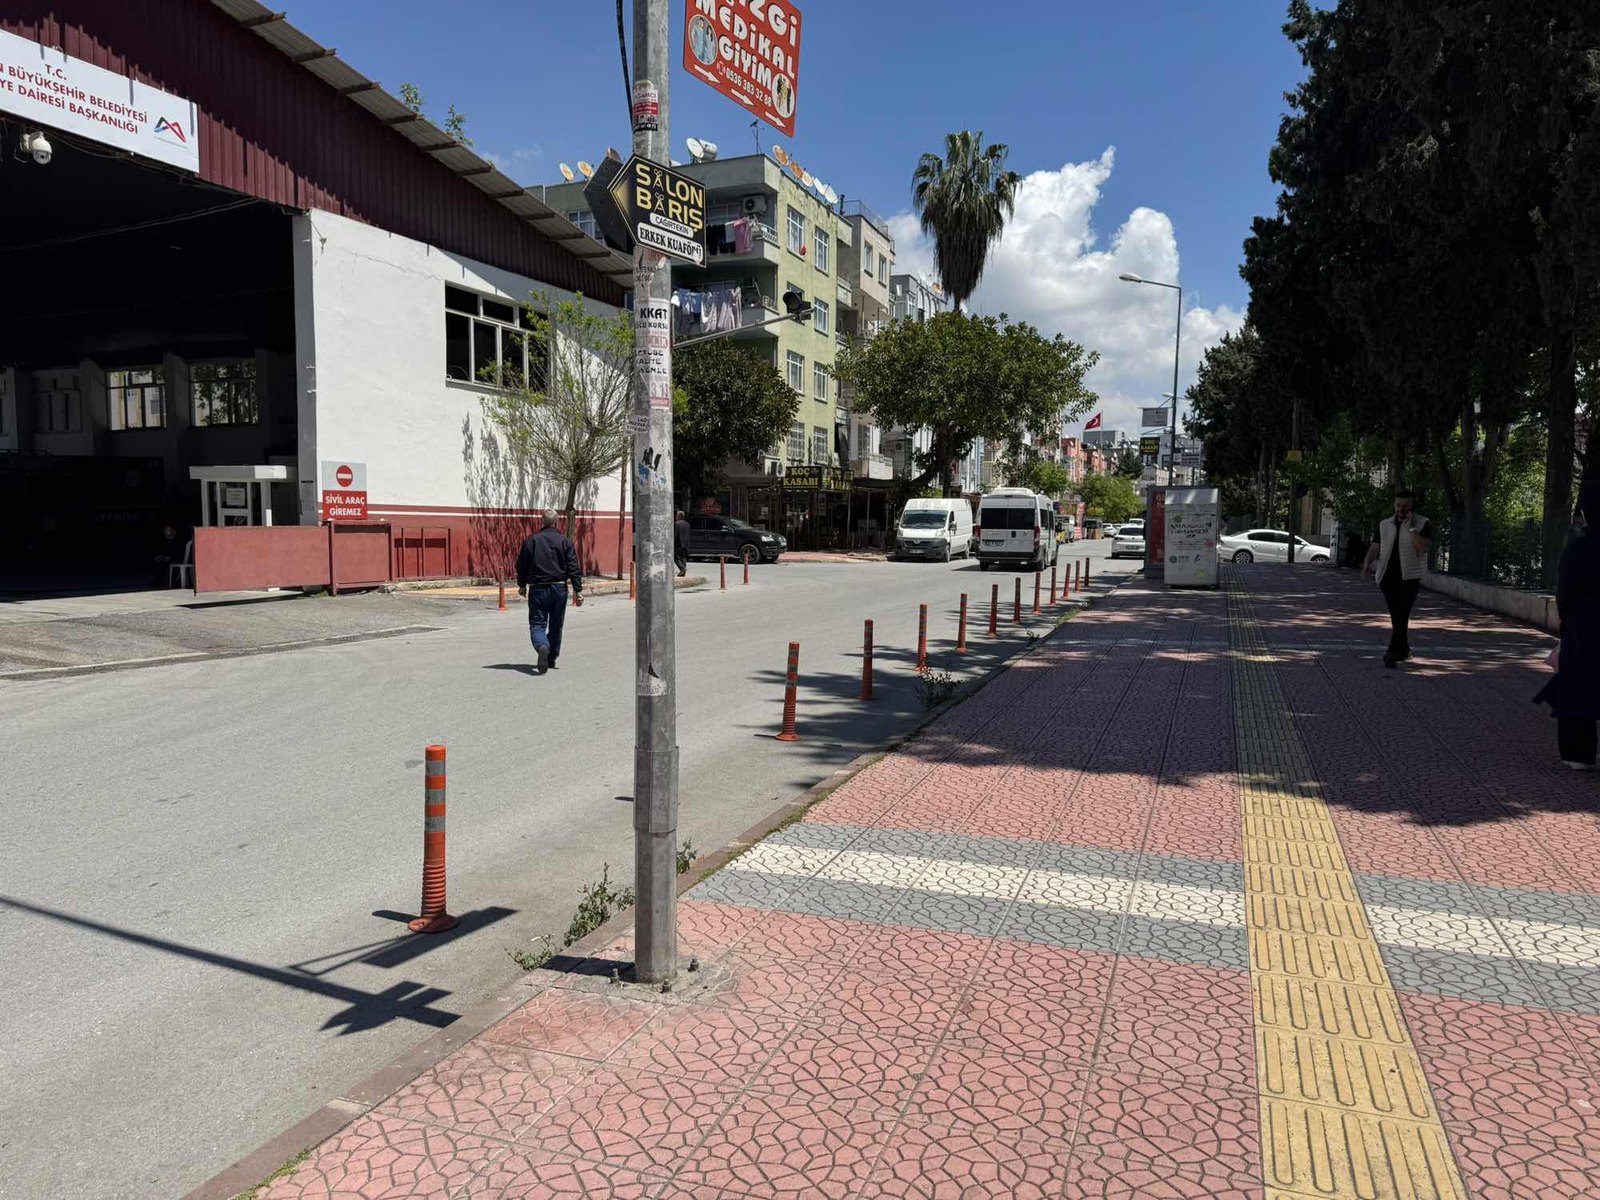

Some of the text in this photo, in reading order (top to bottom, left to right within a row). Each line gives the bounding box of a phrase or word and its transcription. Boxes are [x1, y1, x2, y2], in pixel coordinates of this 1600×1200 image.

[45, 64, 67, 80] T.C.
[9, 66, 86, 102] BÜYÜKŞEHİR
[90, 96, 148, 123] BELEDİYESİ
[18, 85, 65, 109] DAİRESİ
[69, 103, 138, 134] BAŞKANLIĞI
[640, 227, 667, 247] ERKEK
[791, 468, 810, 477] KOÇ
[783, 478, 818, 486] KASABI
[325, 494, 365, 507] SİVİL ARAÇ
[329, 505, 362, 516] GİREMEZ
